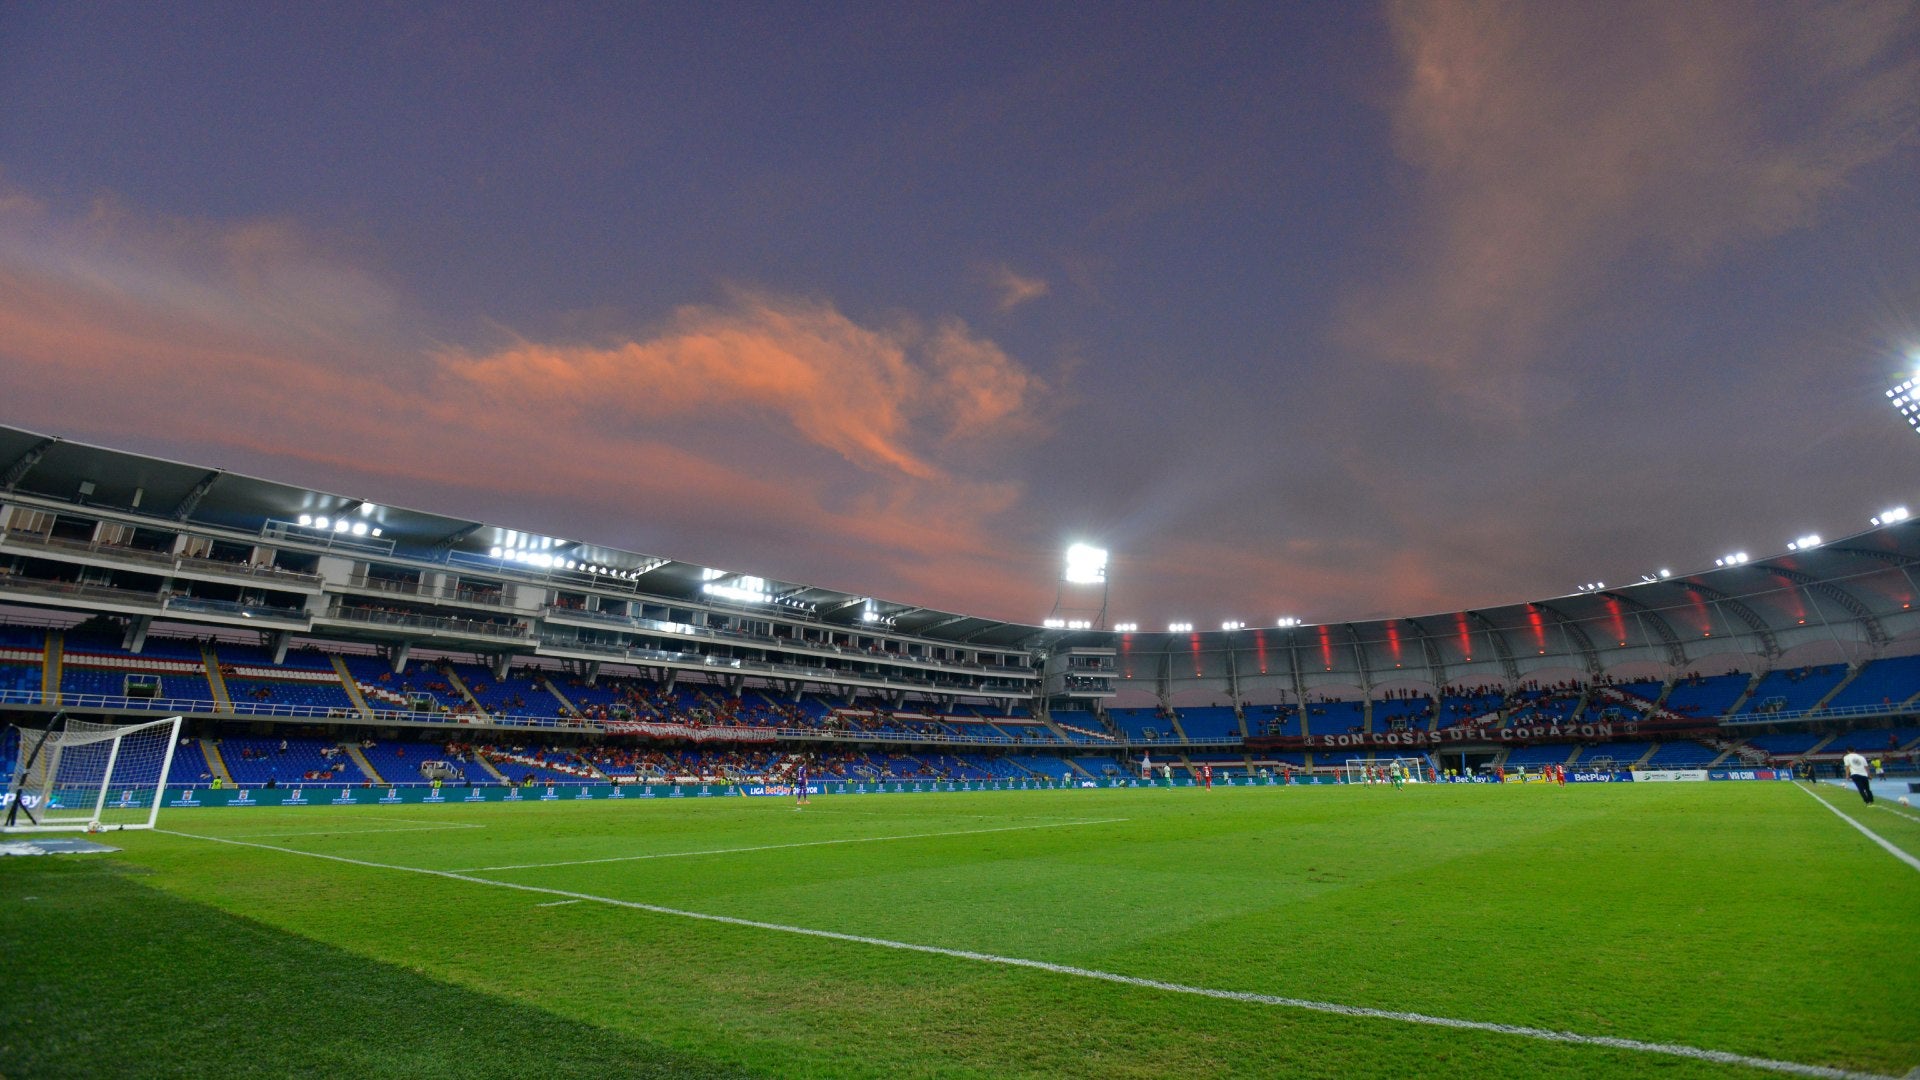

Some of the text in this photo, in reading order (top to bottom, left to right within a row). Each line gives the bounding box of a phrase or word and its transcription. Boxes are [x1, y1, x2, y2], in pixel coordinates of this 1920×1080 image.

[1324, 725, 1613, 747] SON COSAS DEL CORAZON
[1574, 773, 1610, 783] BetPlay
[750, 787, 764, 795] LIGA
[765, 785, 791, 796] BetPlay
